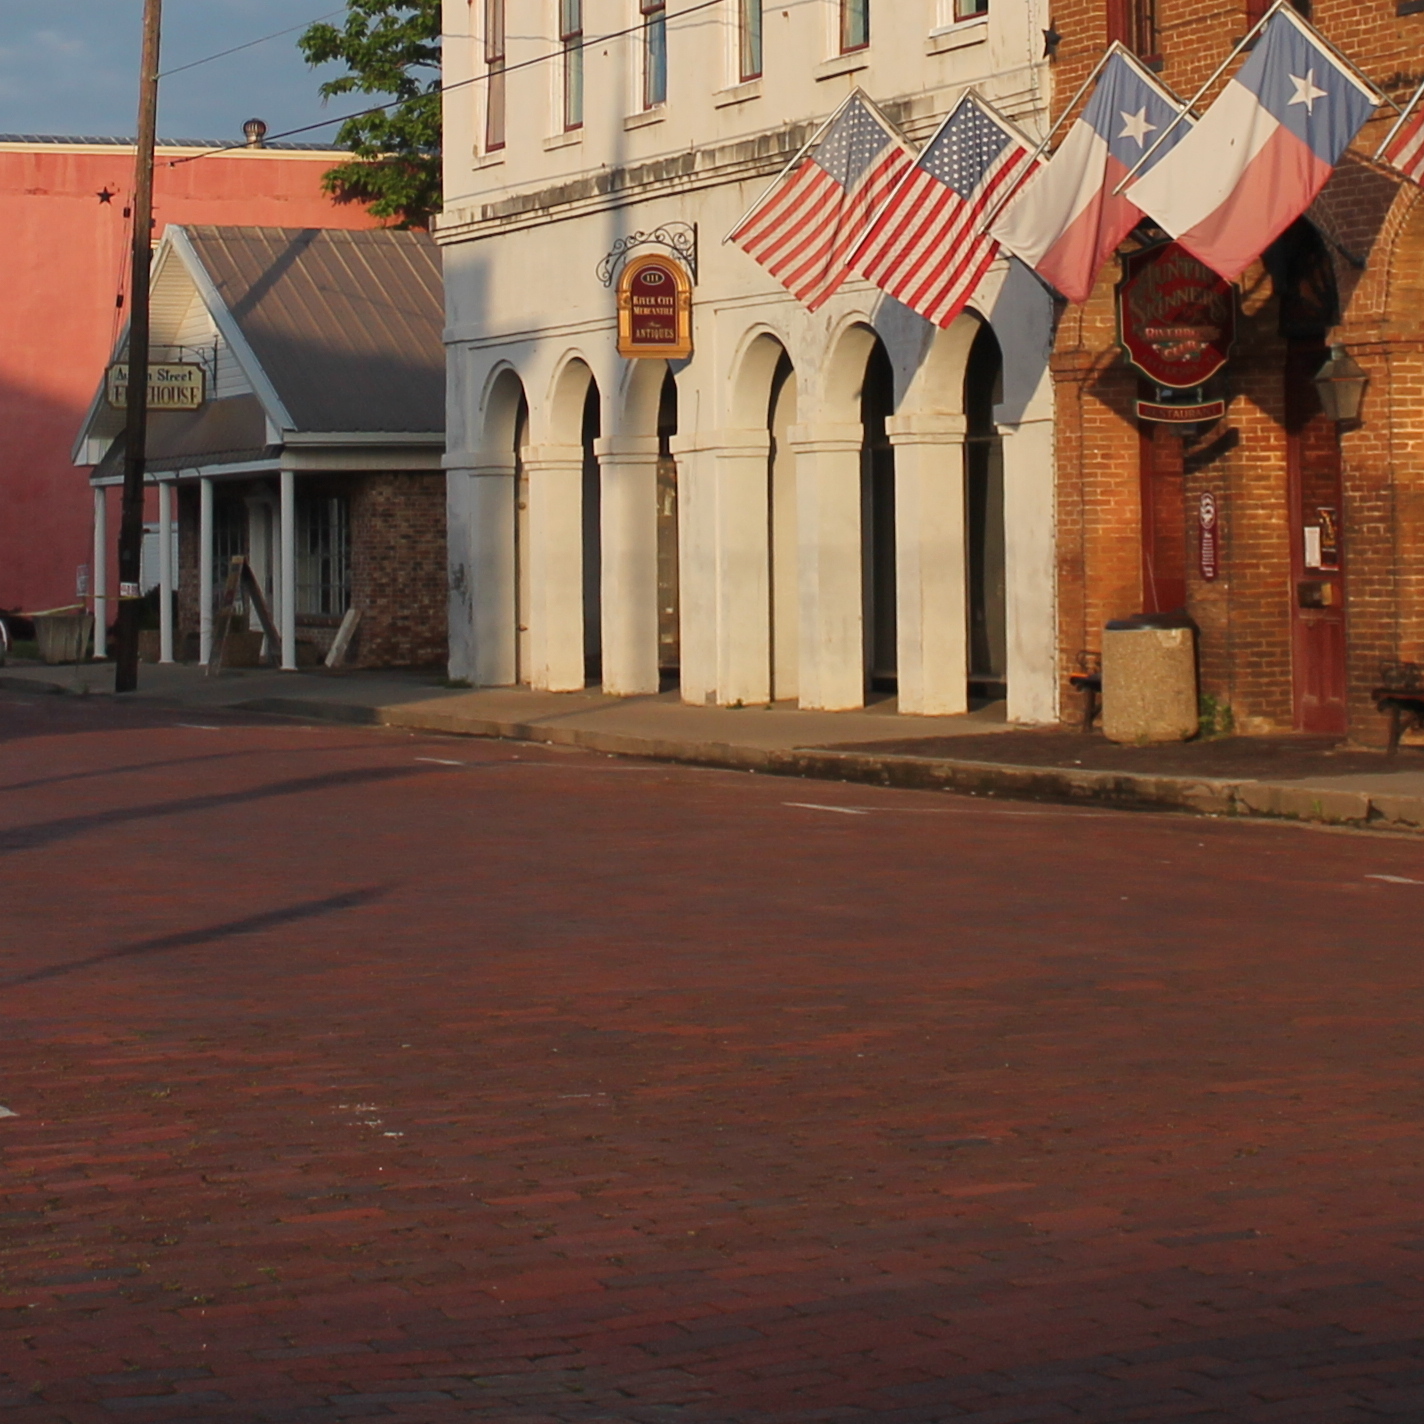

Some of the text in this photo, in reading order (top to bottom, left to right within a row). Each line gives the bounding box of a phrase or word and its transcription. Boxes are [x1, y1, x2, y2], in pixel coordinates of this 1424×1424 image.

[633, 296, 673, 305] RIVER CITY
[633, 306, 673, 315] MERCANTILE
[636, 329, 674, 340] ANTIQUES
[157, 368, 192, 381] Street
[1143, 404, 1218, 419] RESTAURANT
